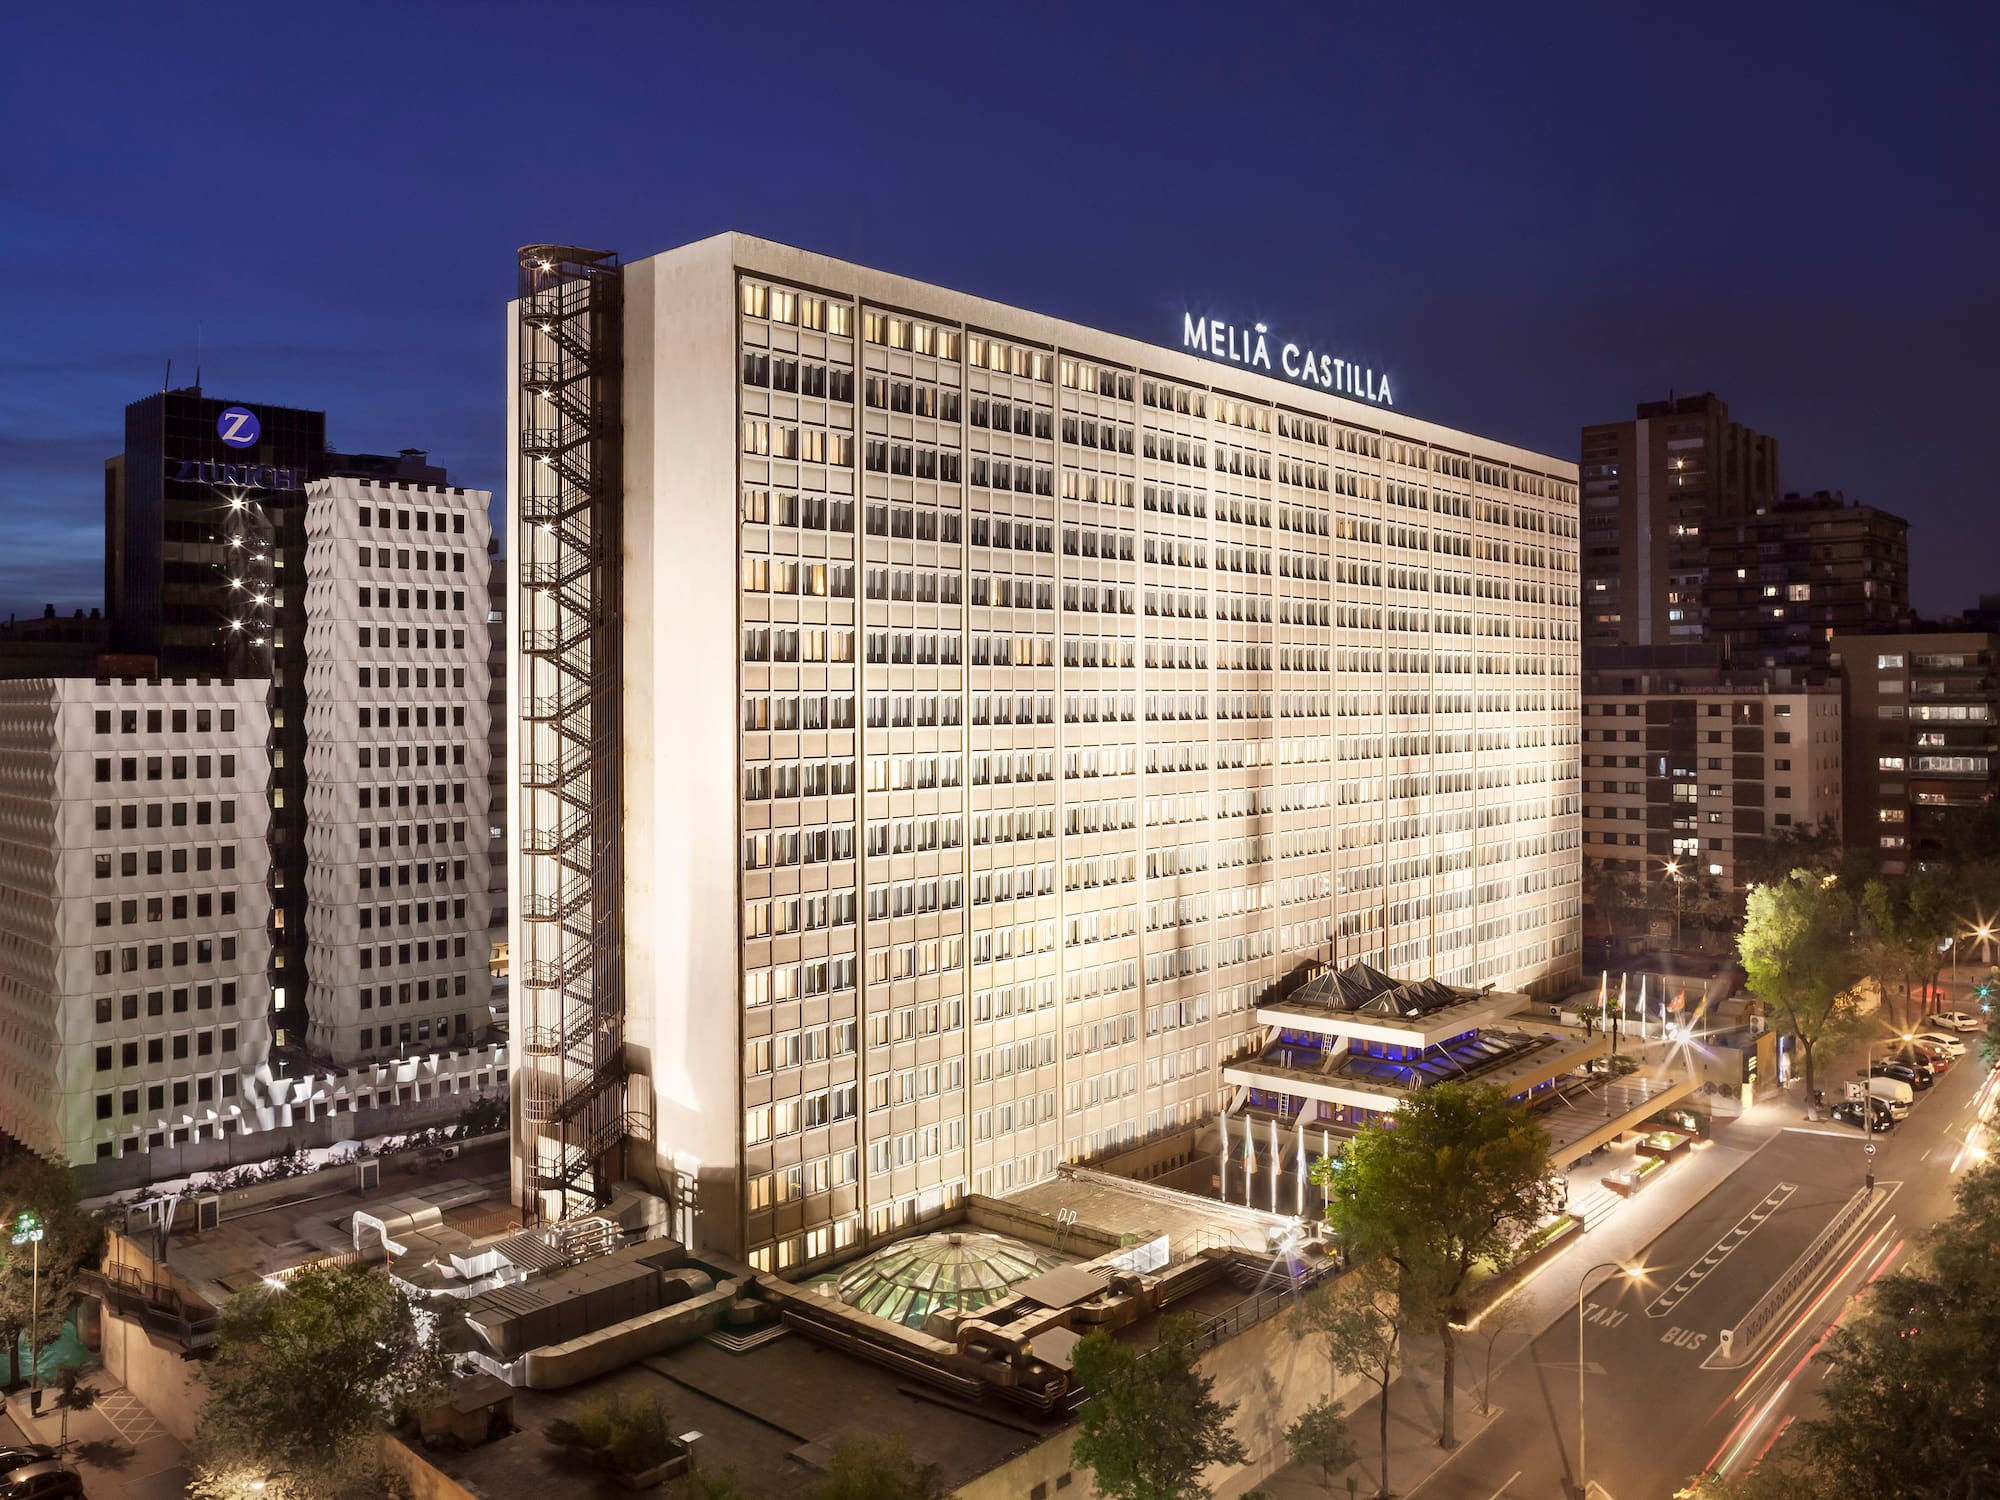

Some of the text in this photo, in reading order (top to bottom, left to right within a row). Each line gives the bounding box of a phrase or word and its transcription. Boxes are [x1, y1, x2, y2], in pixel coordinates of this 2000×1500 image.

[1282, 343, 1393, 405] CASTILLA
[222, 413, 254, 443] Z
[174, 460, 297, 491] ZURICH
[1582, 1302, 1630, 1329] TAXI
[1659, 1326, 1708, 1350] BUS
